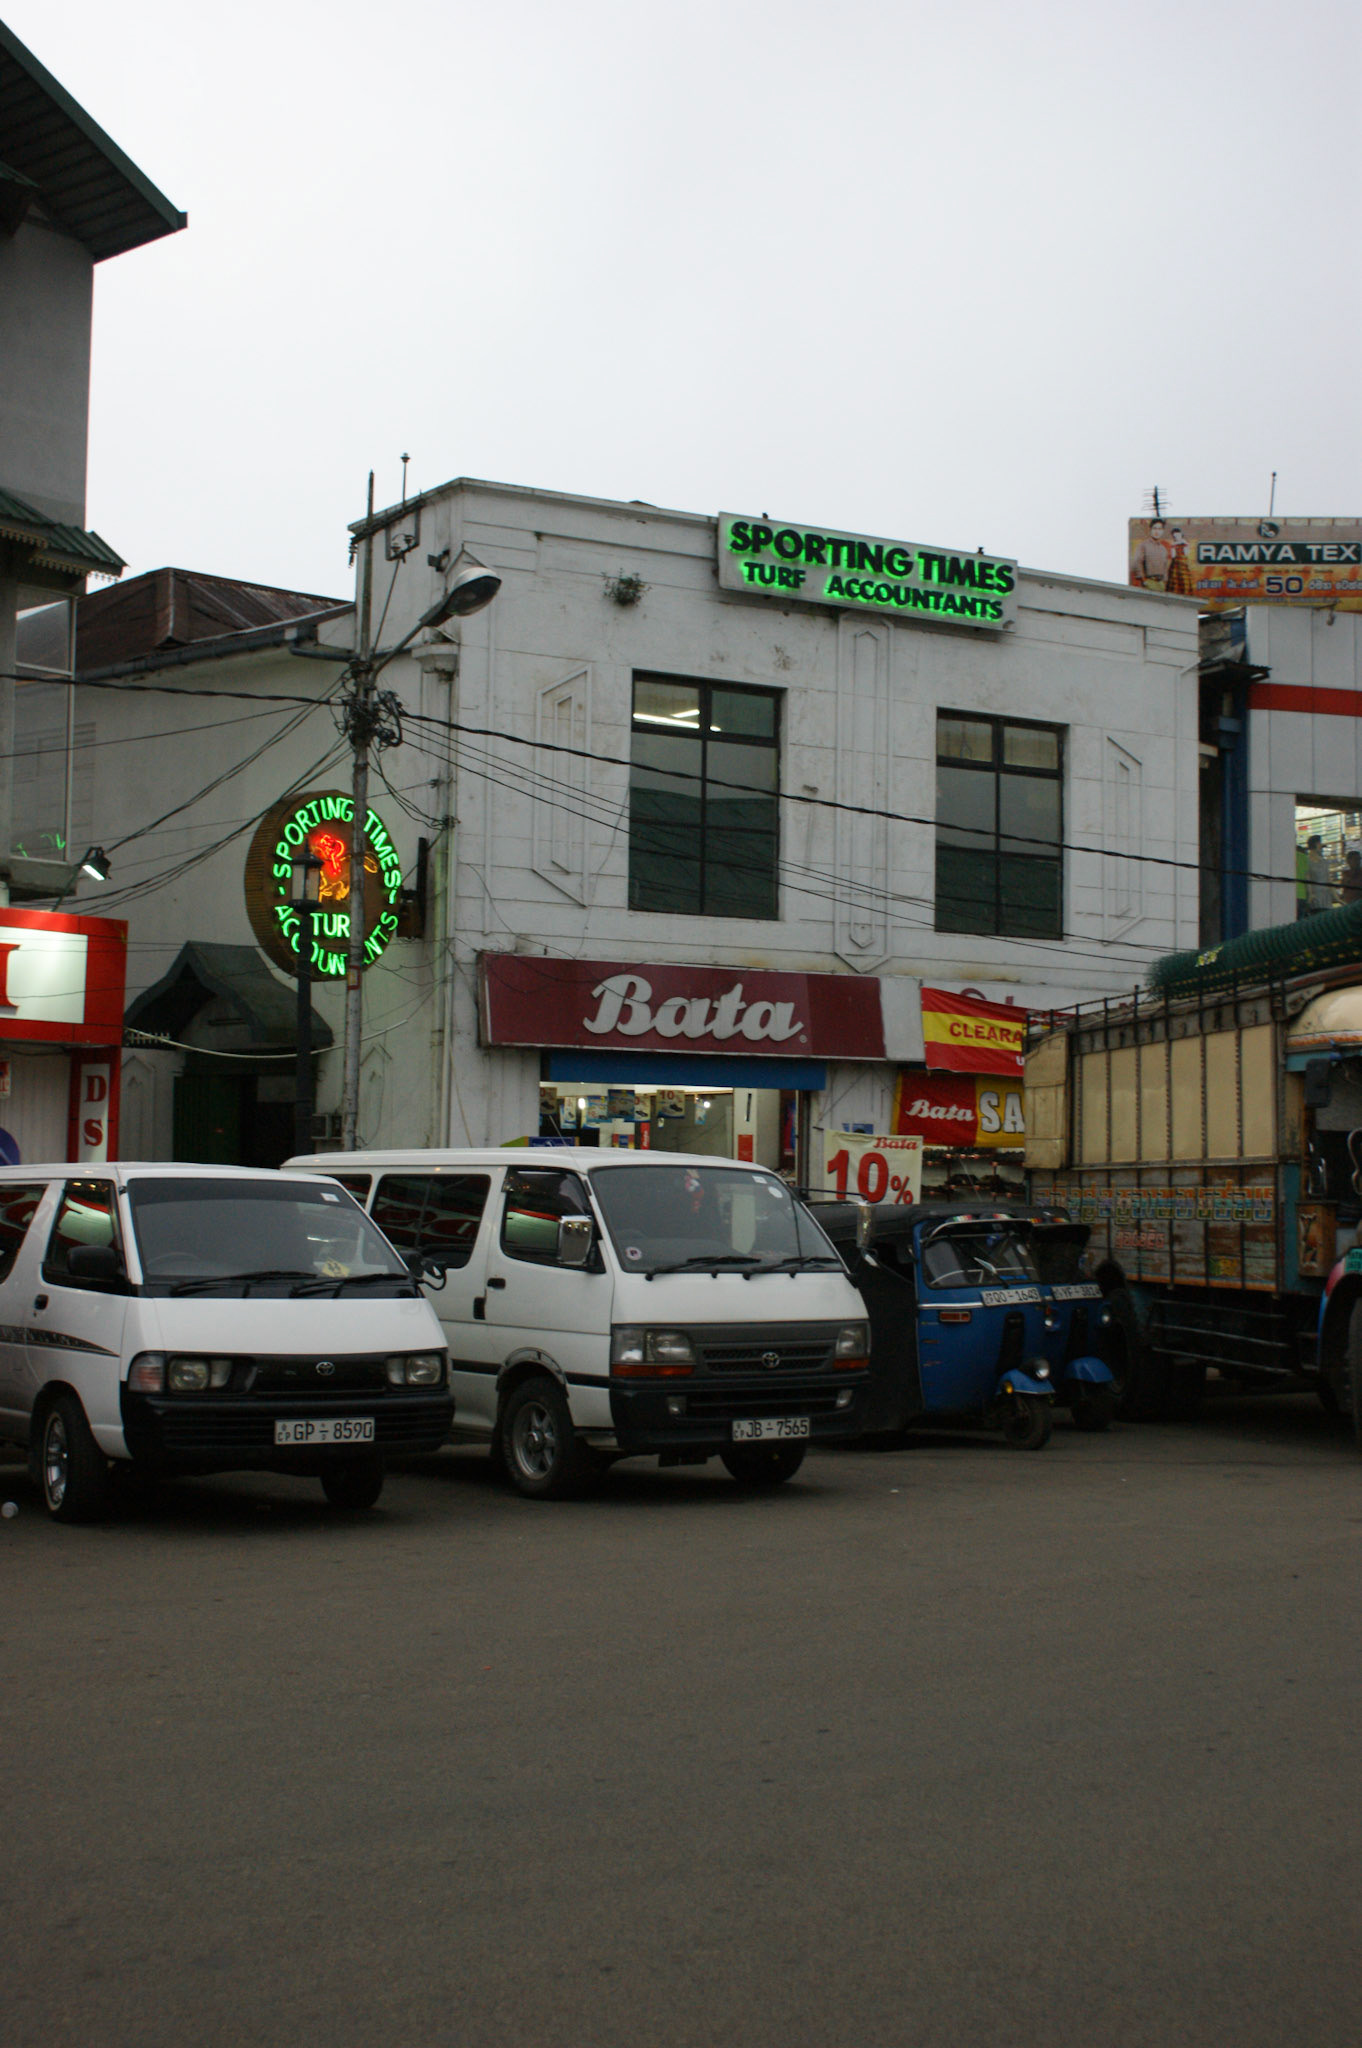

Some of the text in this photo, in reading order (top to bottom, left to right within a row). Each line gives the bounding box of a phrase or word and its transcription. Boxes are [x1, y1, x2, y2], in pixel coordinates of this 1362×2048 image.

[730, 521, 1016, 594] SPORTING TIMES
[1199, 544, 1358, 561] RAMYA TEX
[743, 561, 1004, 620] TURF ACCOUNTANTS
[1265, 575, 1304, 594] 50
[273, 796, 401, 888] SPORTING TIMES
[310, 912, 351, 938] TUR
[583, 973, 804, 1042] Bata
[905, 1098, 976, 1122] Bata
[872, 1136, 919, 1151] Bata
